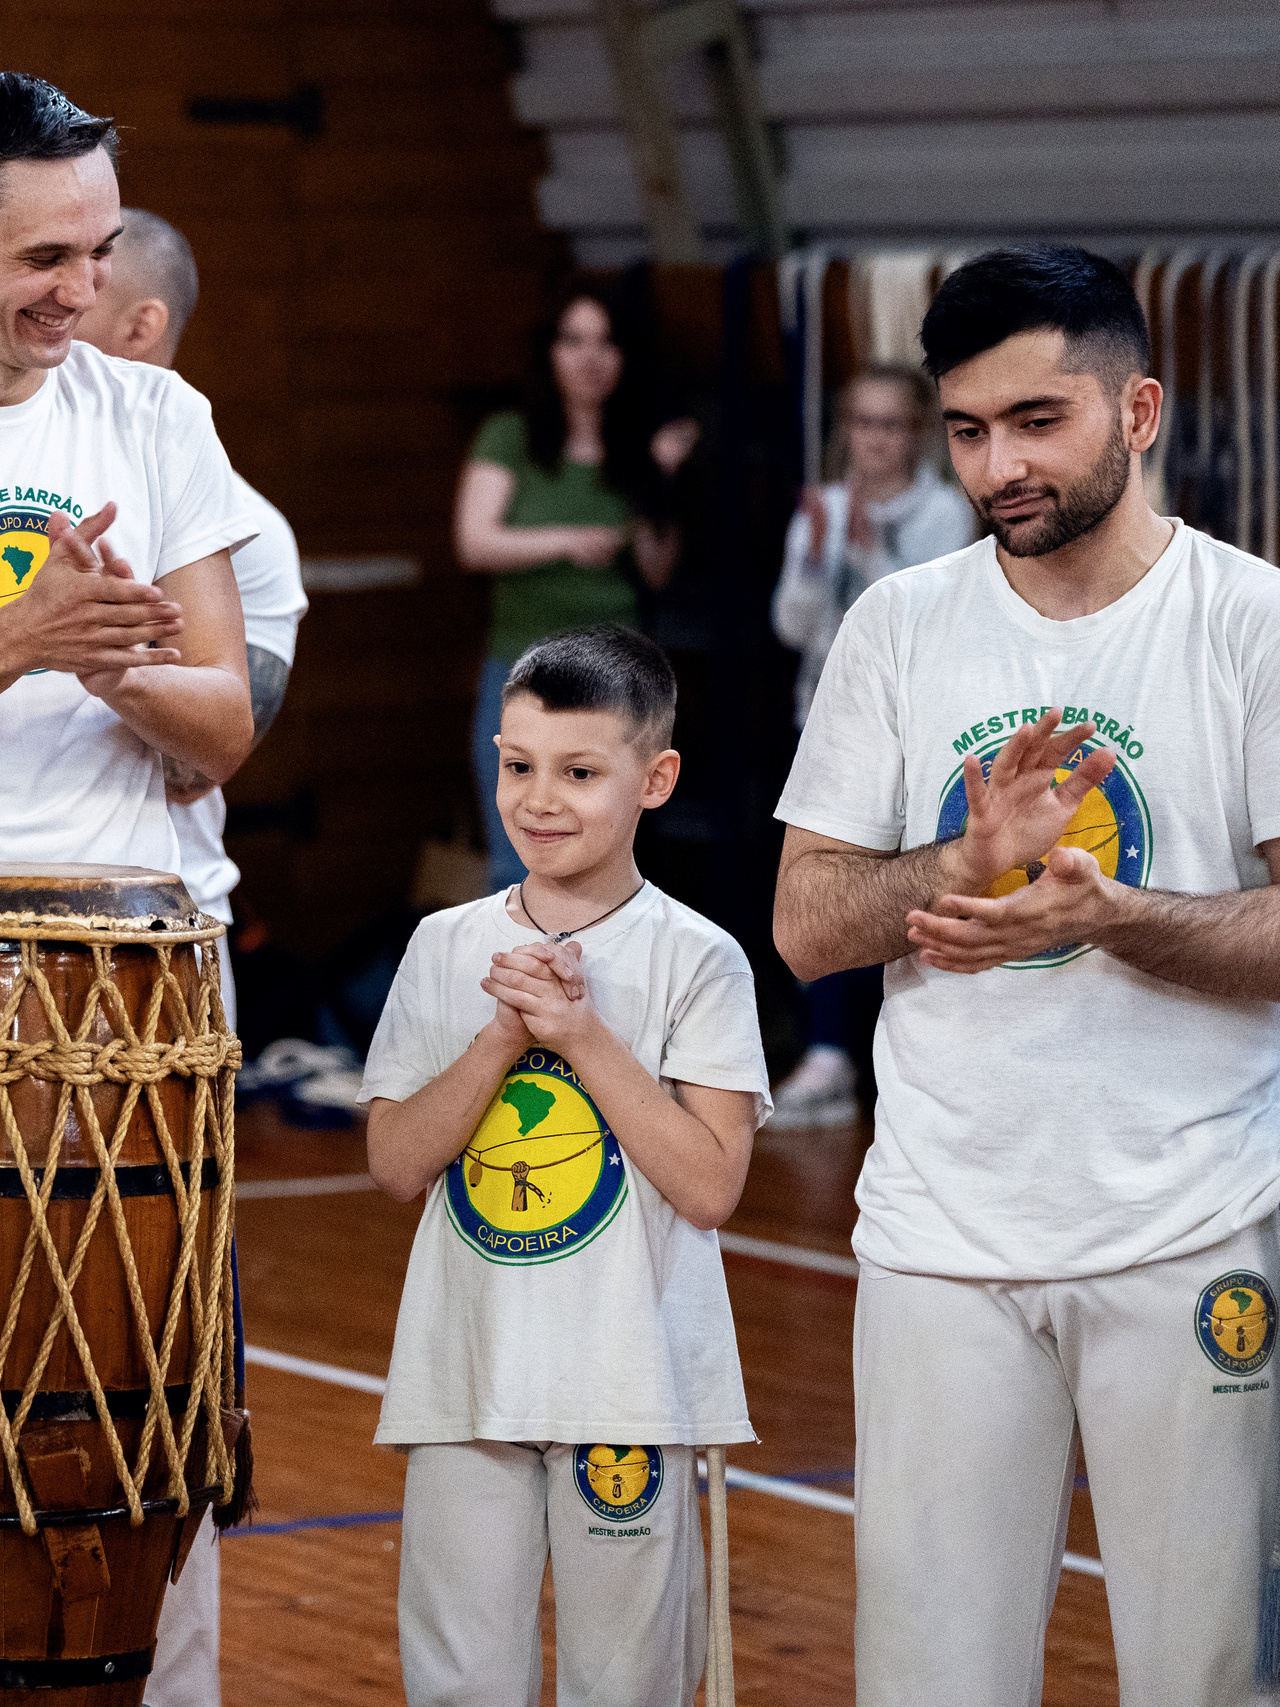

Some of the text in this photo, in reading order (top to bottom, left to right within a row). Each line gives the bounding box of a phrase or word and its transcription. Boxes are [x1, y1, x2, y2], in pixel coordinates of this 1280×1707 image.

[14, 485, 83, 519] BARRÃO
[1061, 706, 1144, 760] BARRÃO
[477, 1224, 578, 1252] CAPOEIRA
[1210, 1276, 1244, 1297] GRUPO
[1217, 1350, 1267, 1370] CAPOEIRA
[1212, 1385, 1242, 1394] MESTRE
[593, 1498, 648, 1515] CAPOEIRA
[588, 1526, 651, 1538] MESTRE BARRÃO
